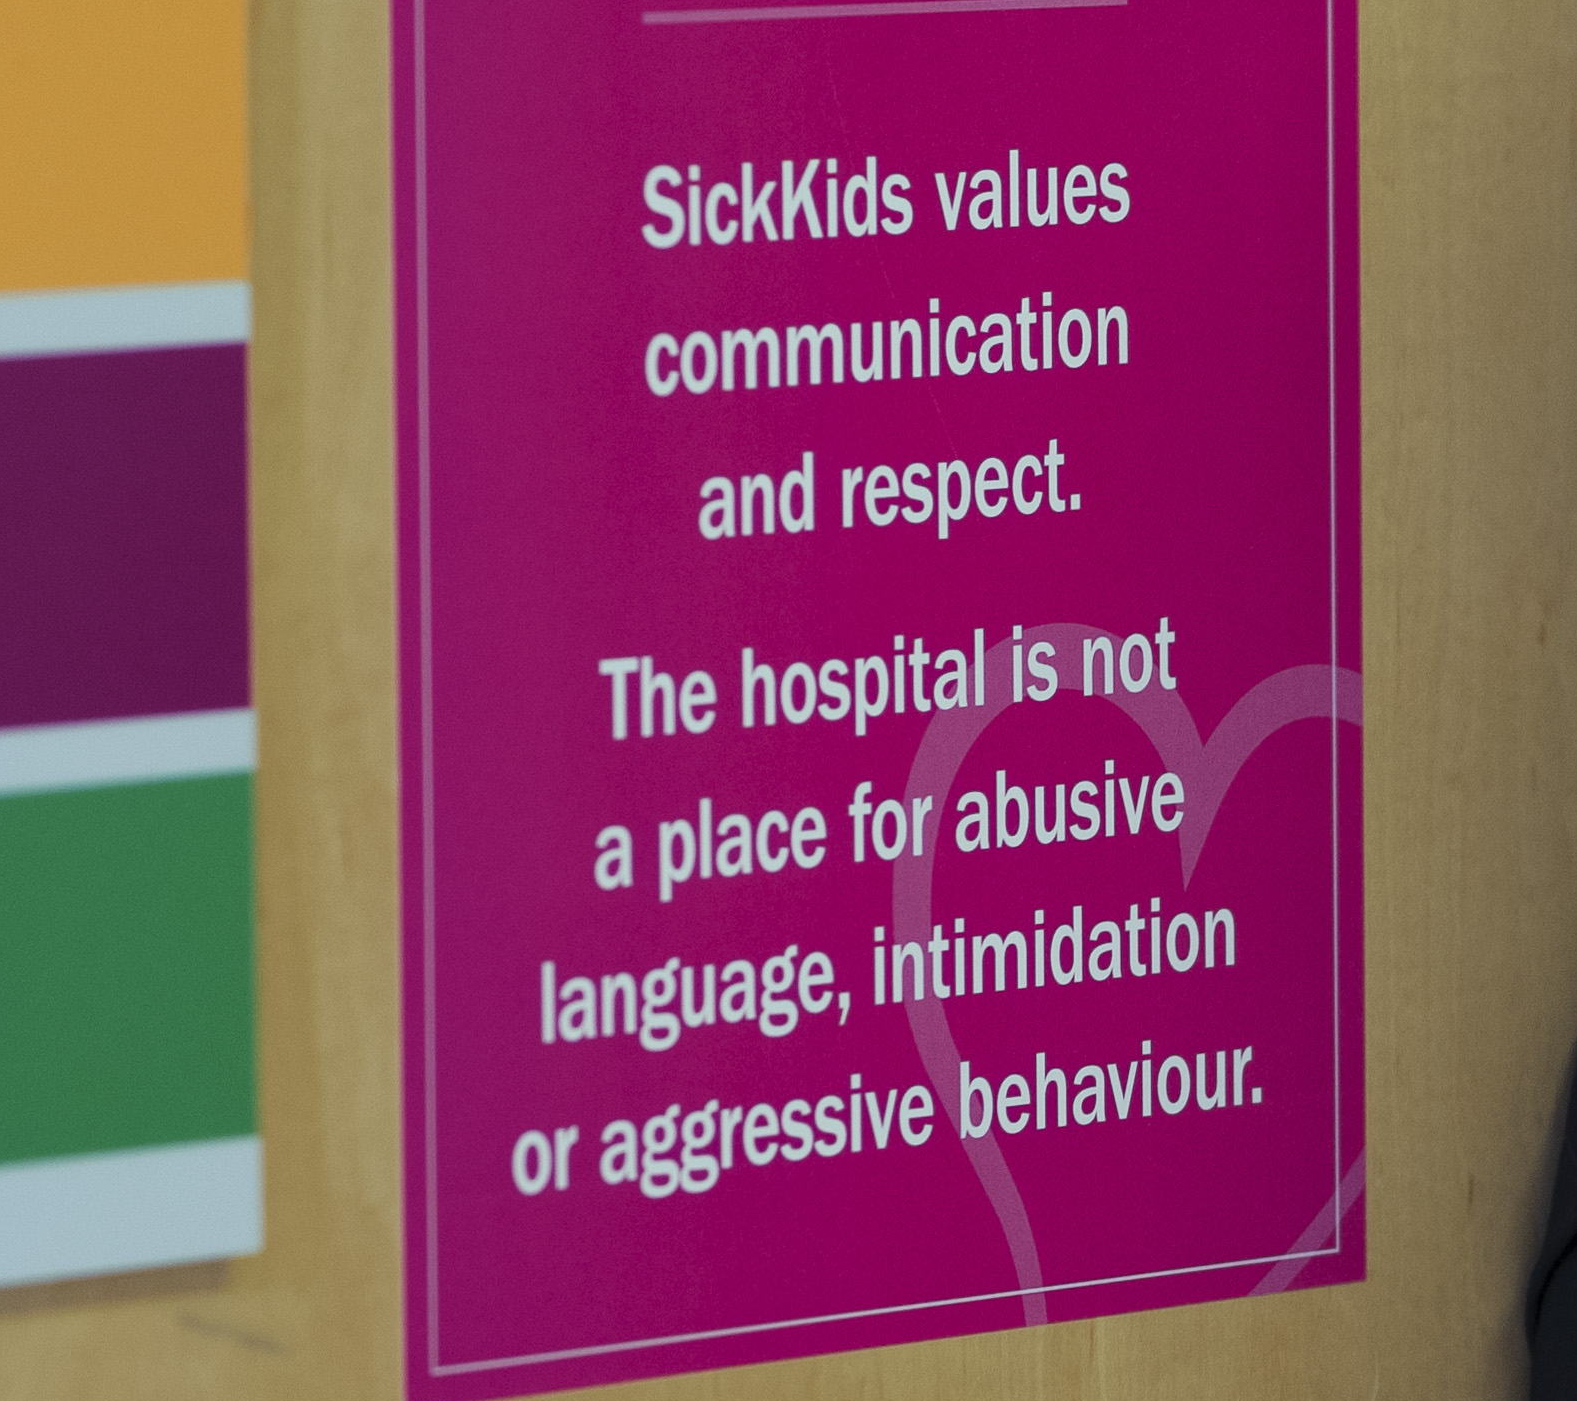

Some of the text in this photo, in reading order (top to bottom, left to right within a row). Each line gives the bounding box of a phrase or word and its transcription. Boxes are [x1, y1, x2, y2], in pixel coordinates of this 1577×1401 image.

[641, 149, 1131, 249] SickKids values
[644, 291, 1129, 397] communication
[698, 438, 1082, 540] and respect.
[598, 616, 1177, 741] The hospital is not
[594, 759, 1185, 903] a place for abusive
[541, 897, 1235, 1052] language, intimidation
[512, 1039, 1263, 1199] or aggressive behaviour.
